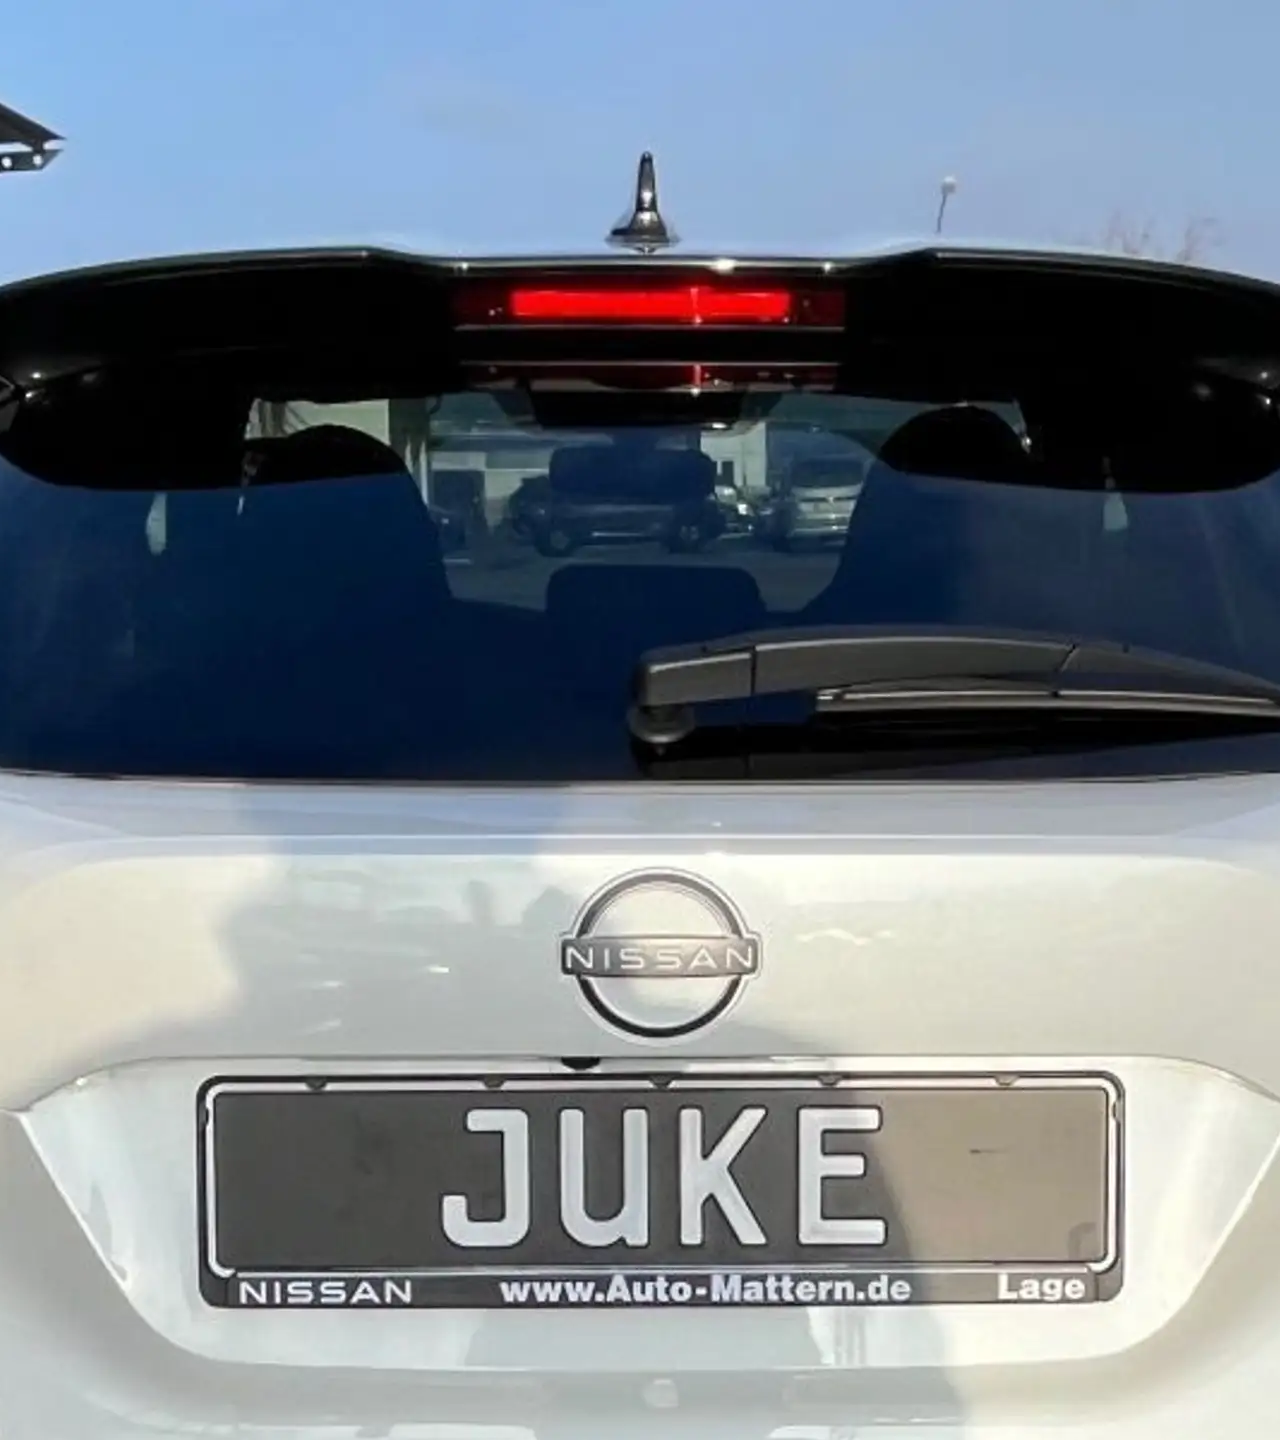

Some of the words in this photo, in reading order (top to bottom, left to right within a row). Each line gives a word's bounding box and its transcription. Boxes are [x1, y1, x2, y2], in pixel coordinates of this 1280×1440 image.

[565, 945, 753, 971] NISSAN
[441, 1106, 888, 1248] JUKE
[238, 1280, 413, 1304] NISSAN
[499, 1273, 912, 1303] www.Auto-Mattern.de
[997, 1273, 1086, 1303] Lage
